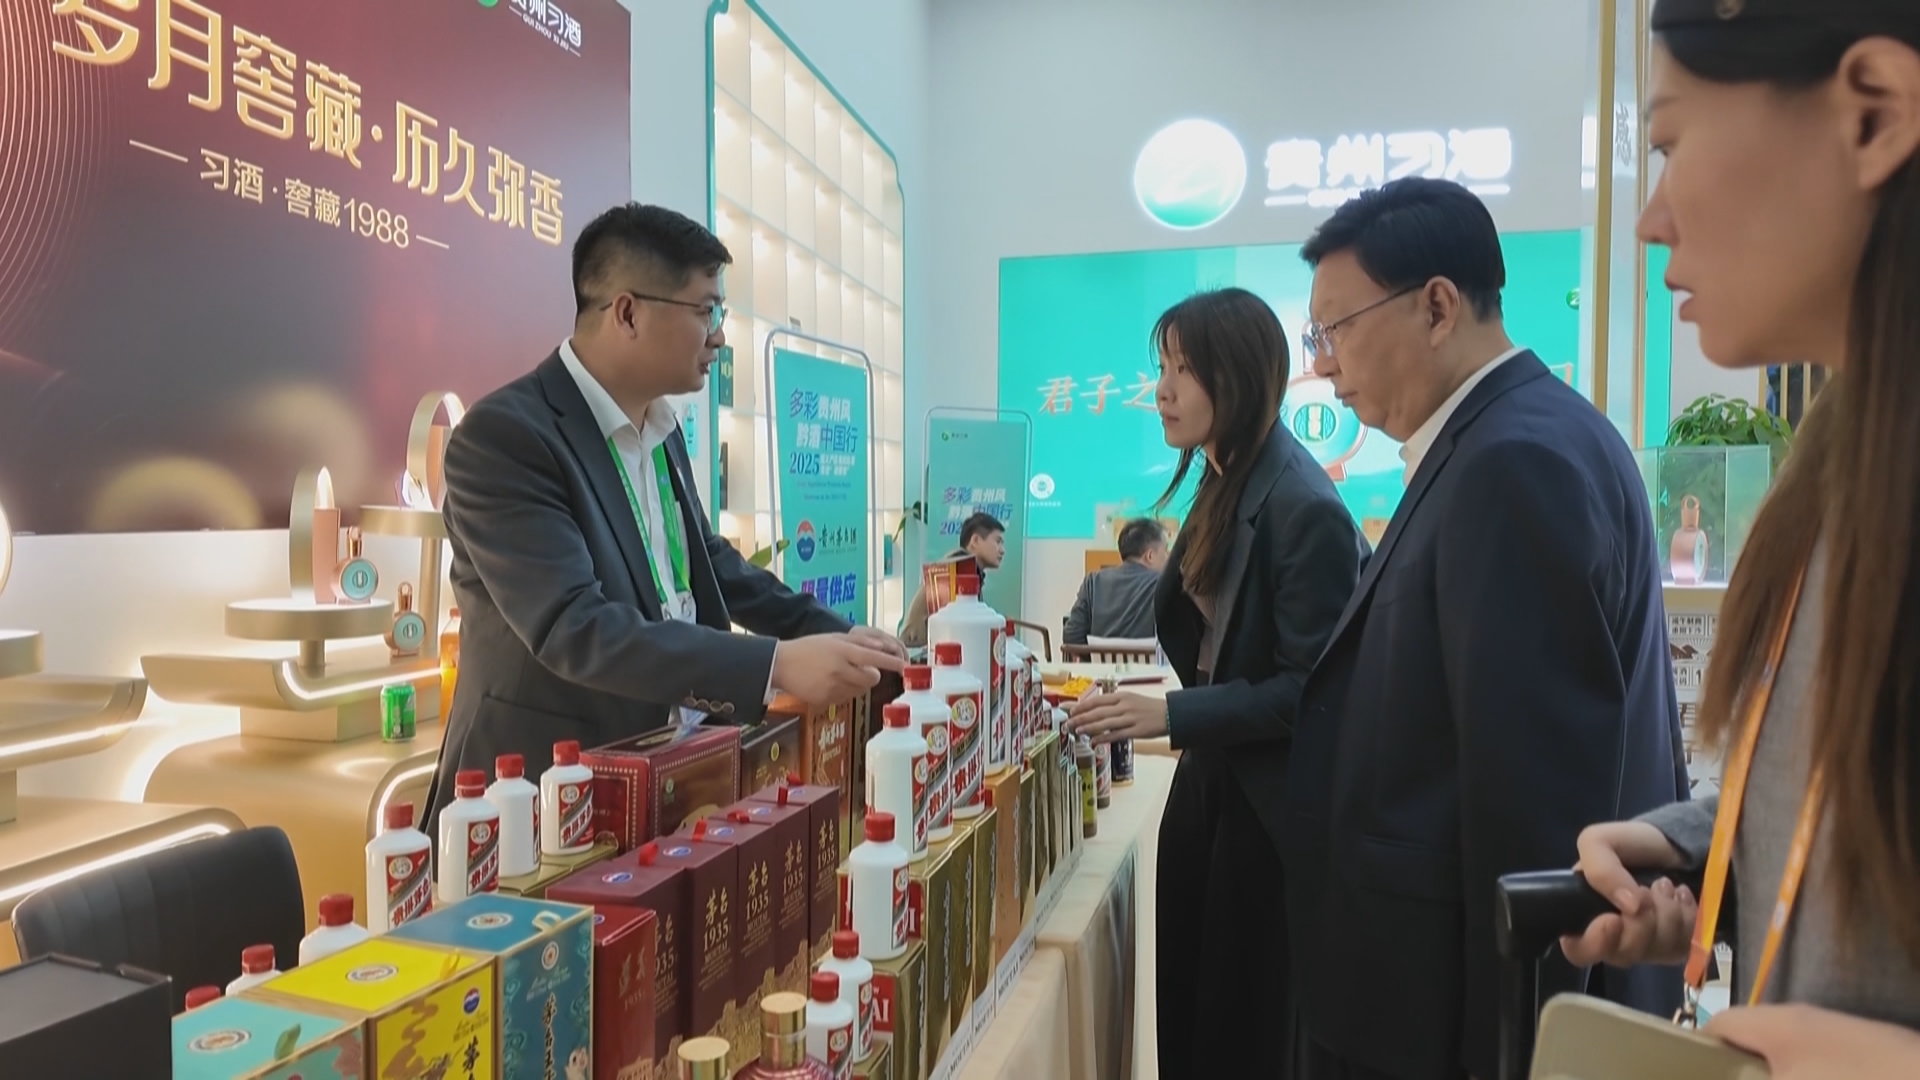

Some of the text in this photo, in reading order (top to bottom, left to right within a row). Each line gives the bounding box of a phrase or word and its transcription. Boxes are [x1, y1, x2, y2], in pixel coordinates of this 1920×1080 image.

[511, 0, 581, 48] 州习酒
[789, 451, 820, 475] 2025
[939, 521, 962, 535] 202
[818, 844, 835, 871] 1935
[783, 866, 803, 895] 1935
[746, 889, 769, 921] 1935
[704, 916, 729, 953] 1935
